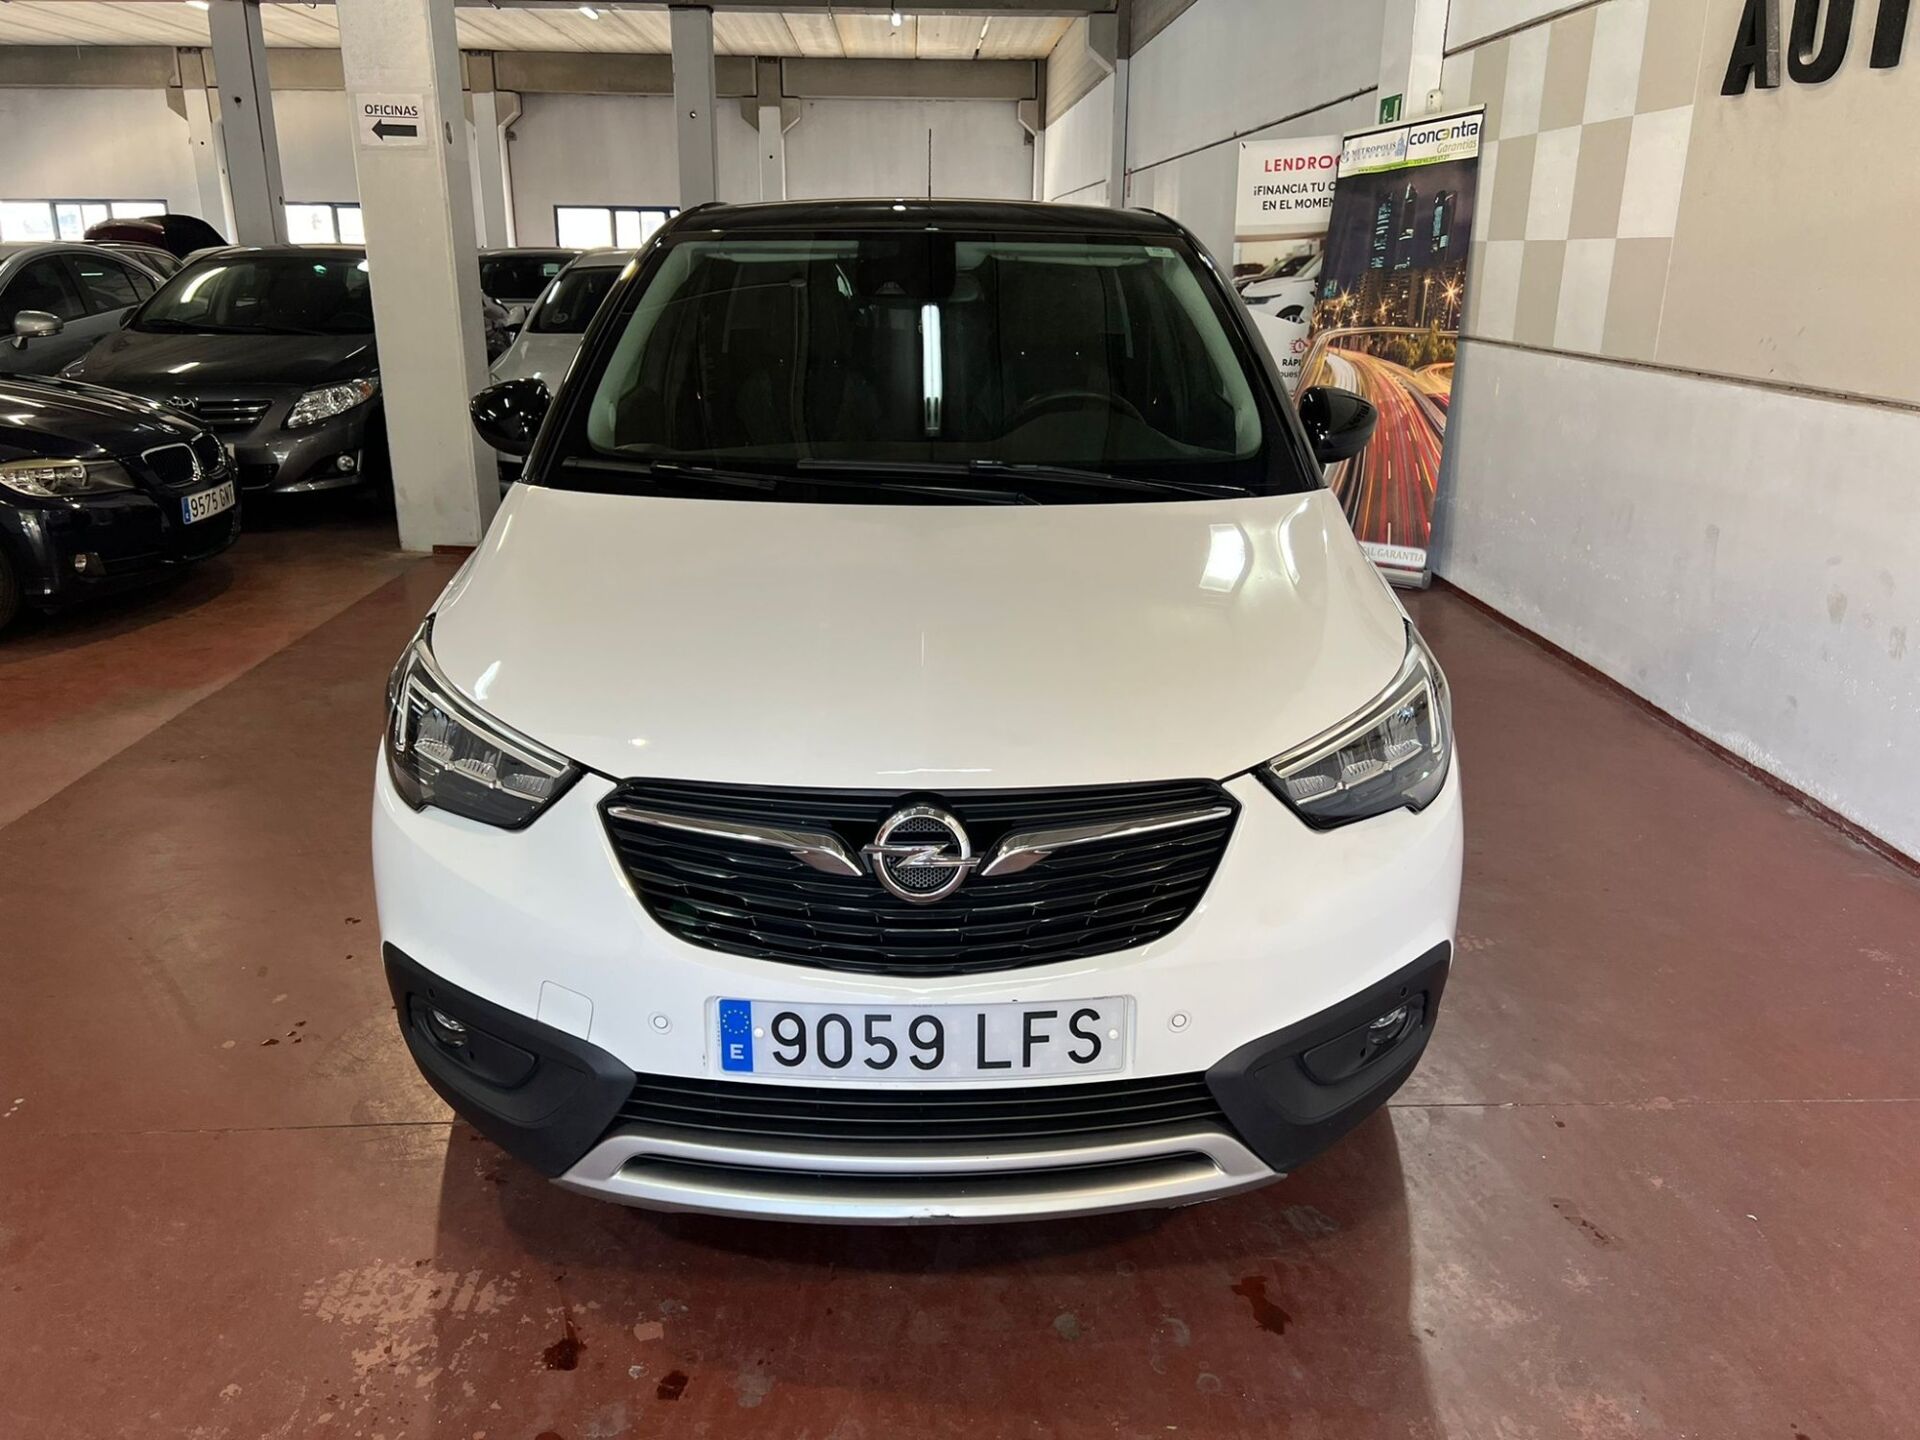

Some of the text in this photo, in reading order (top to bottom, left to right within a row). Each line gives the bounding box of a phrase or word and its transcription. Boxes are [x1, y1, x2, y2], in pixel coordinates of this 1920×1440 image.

[364, 104, 418, 116] OFICINAS
[1310, 181, 1326, 192] TU
[1262, 200, 1277, 210] EN
[1280, 199, 1292, 210] EL
[191, 491, 218, 518] 9575
[1378, 548, 1424, 562] GARANTIA
[730, 1008, 1101, 1070] E 9059 LFS
